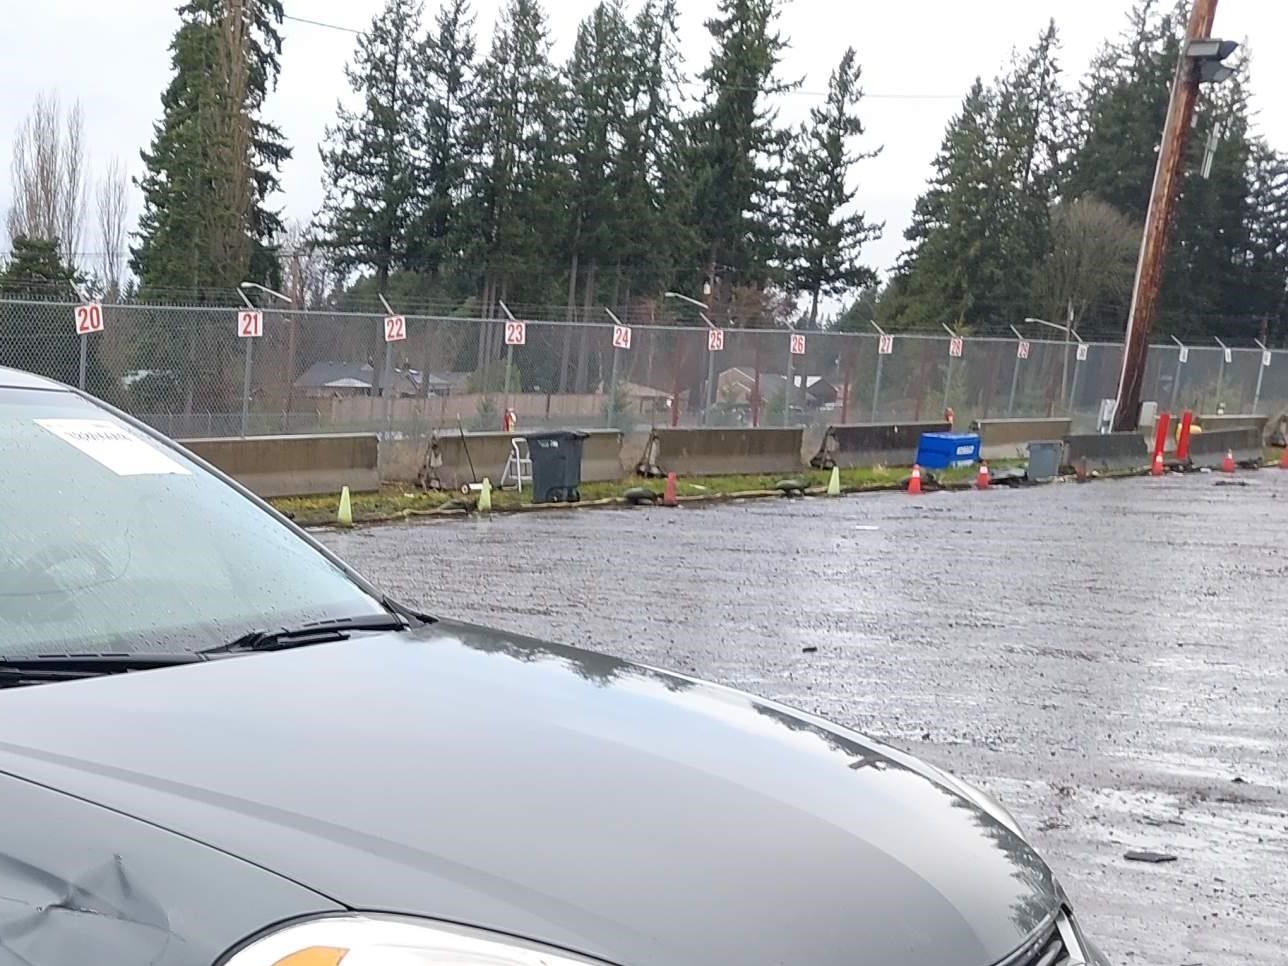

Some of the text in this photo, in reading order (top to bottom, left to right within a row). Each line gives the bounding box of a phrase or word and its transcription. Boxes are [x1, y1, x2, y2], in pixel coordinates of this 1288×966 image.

[79, 306, 101, 331] 20
[243, 313, 259, 336] 21
[387, 319, 403, 338] 22
[507, 324, 523, 342] 23
[616, 328, 629, 347] 24
[711, 332, 722, 349] 25
[792, 337, 804, 353] 26
[881, 336, 892, 353] 27
